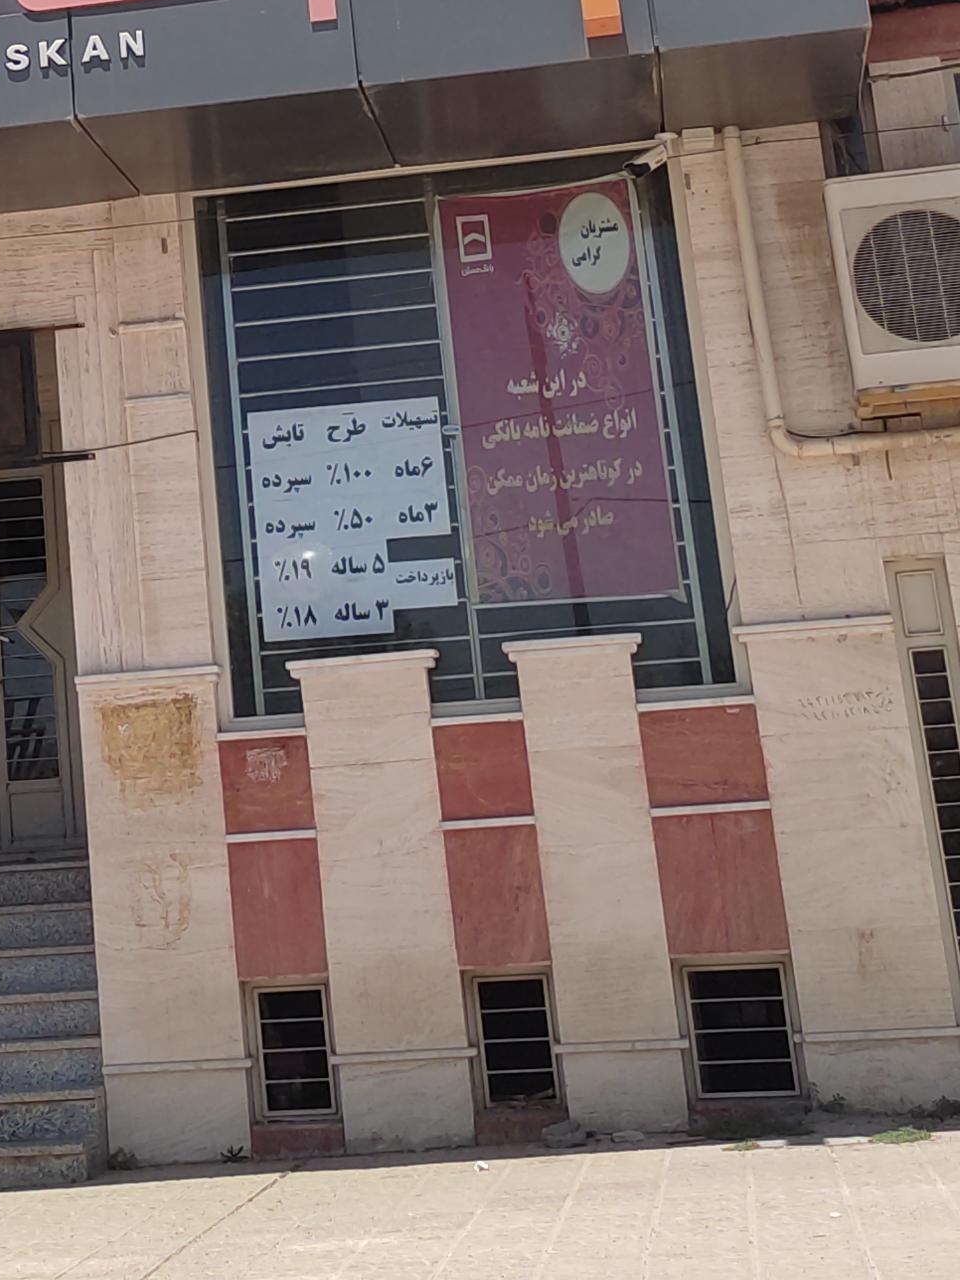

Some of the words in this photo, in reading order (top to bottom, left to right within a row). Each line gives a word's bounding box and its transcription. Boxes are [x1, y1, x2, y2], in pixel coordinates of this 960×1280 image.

[580, 218, 619, 238] مشتریان
[572, 246, 601, 266] گرامی
[507, 371, 540, 400] شعبه
[542, 368, 566, 398] این
[569, 371, 586, 396] در
[326, 417, 366, 442] طرح
[381, 408, 439, 429] تسهیلات
[523, 415, 551, 439] نامه
[552, 413, 599, 438] ضمانت
[602, 407, 637, 438] انواع
[482, 418, 521, 449] بانکی
[261, 474, 312, 493] سپرده
[487, 468, 523, 496] ممکن
[526, 464, 558, 493] زمان
[626, 460, 643, 484] در
[265, 519, 316, 539] سپرده
[581, 505, 614, 534] صادر
